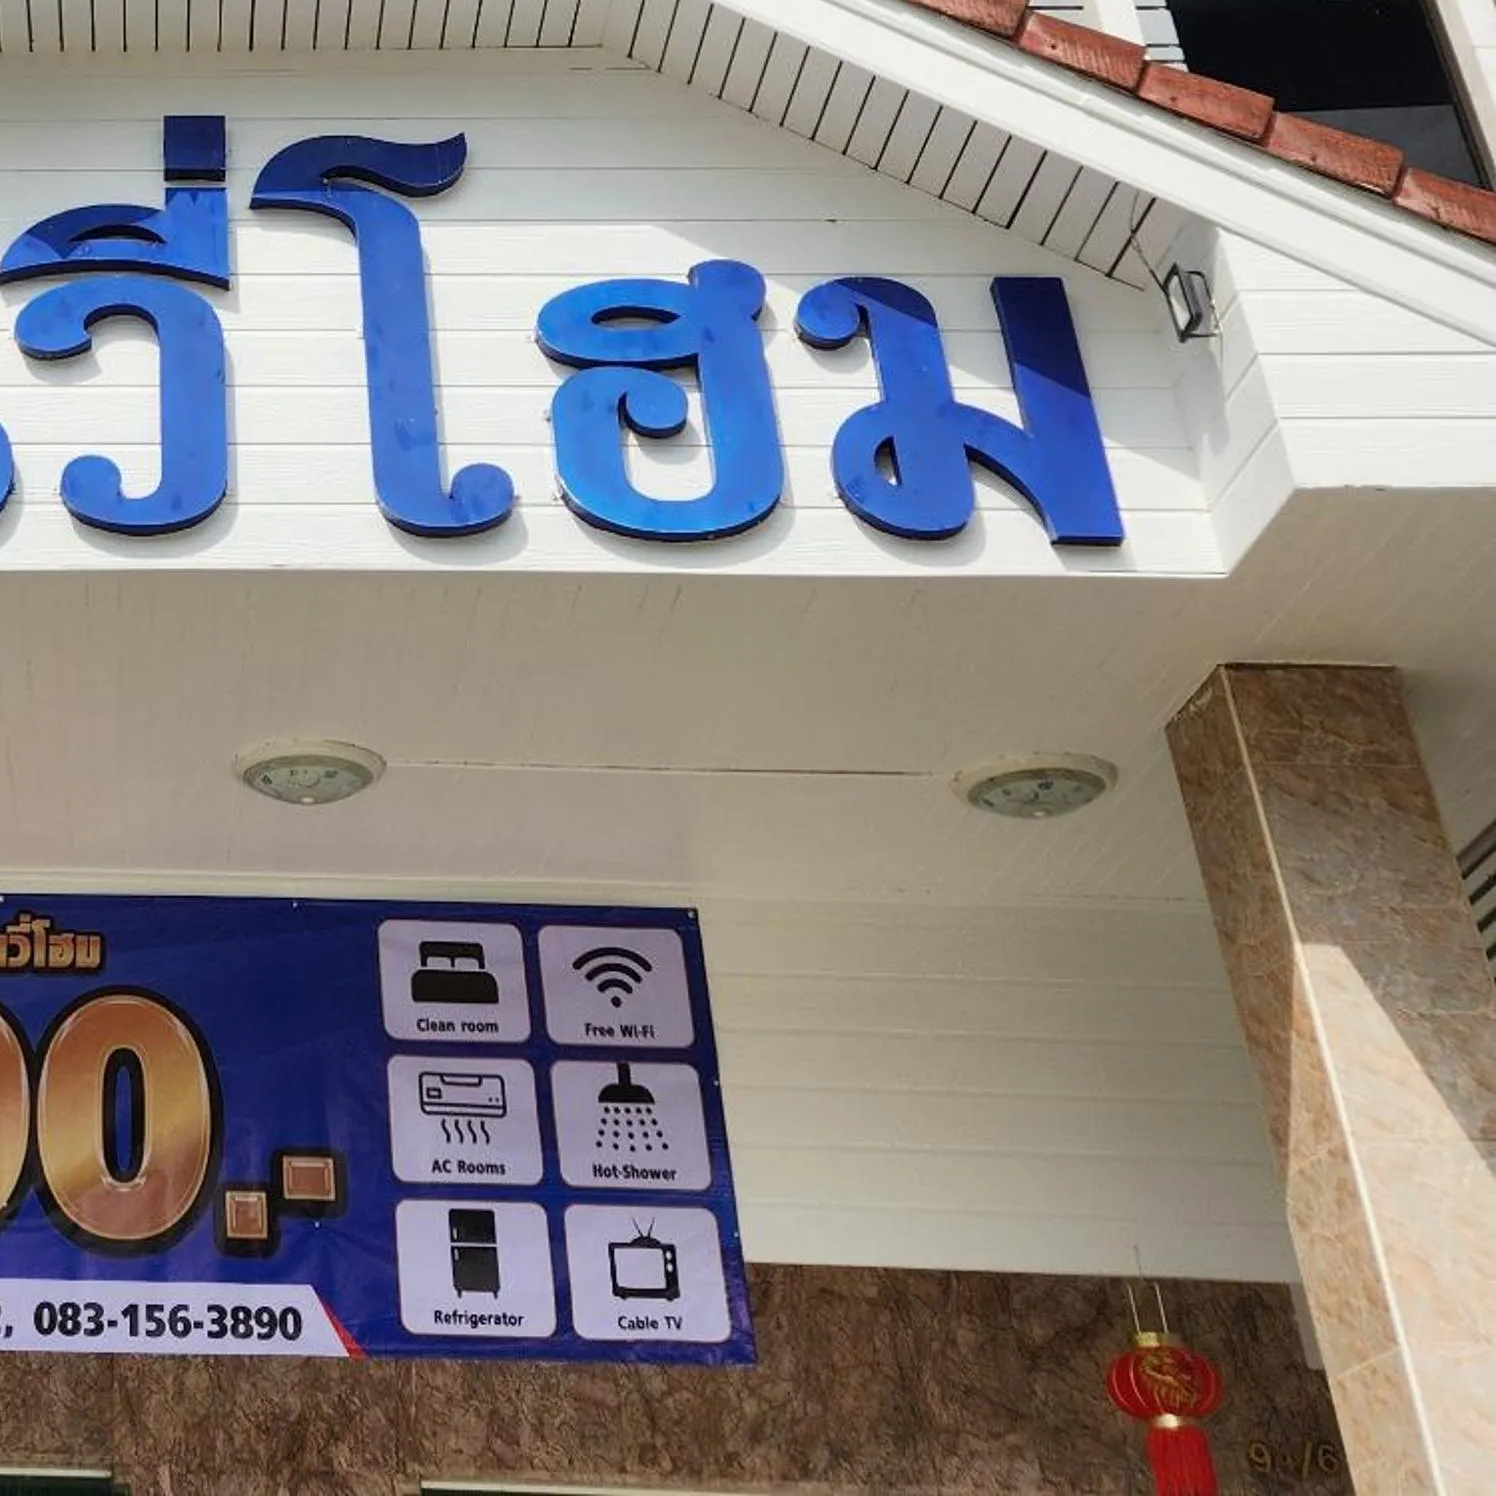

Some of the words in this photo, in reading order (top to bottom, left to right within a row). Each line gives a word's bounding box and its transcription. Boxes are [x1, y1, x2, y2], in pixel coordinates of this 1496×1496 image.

[416, 1017, 455, 1033] Clean
[461, 1020, 499, 1034] room
[585, 1022, 615, 1038] Free
[431, 1158, 452, 1175] AC
[457, 1158, 506, 1177] Rooms
[592, 1163, 677, 1182] Hot-Shower
[33, 1300, 304, 1342] 083-156-3890
[433, 1309, 526, 1330] Refrigerator
[617, 1314, 659, 1331] Cable
[664, 1315, 683, 1332] TV
